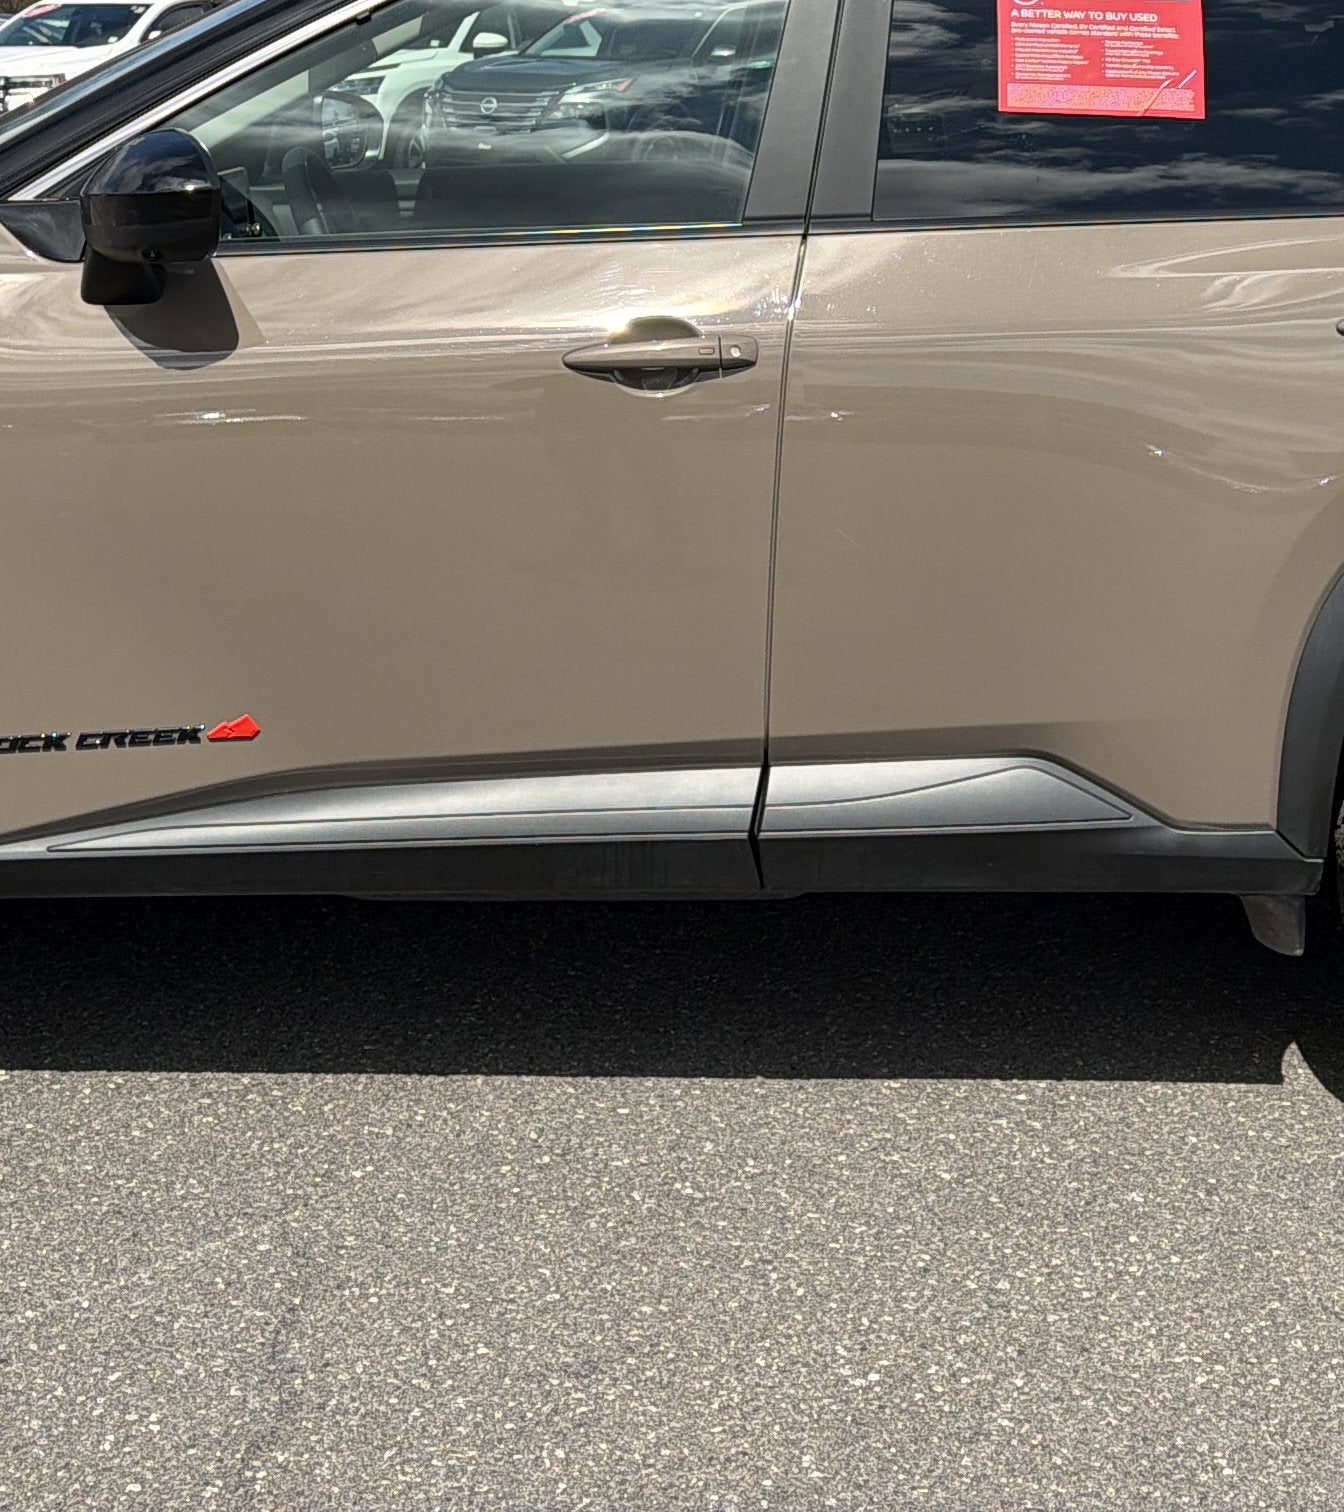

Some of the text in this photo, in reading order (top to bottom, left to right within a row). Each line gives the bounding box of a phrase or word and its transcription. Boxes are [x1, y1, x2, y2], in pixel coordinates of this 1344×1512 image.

[1010, 9, 1158, 23] A BETTER WAY TO BUY USED
[75, 725, 205, 751] CREEK
